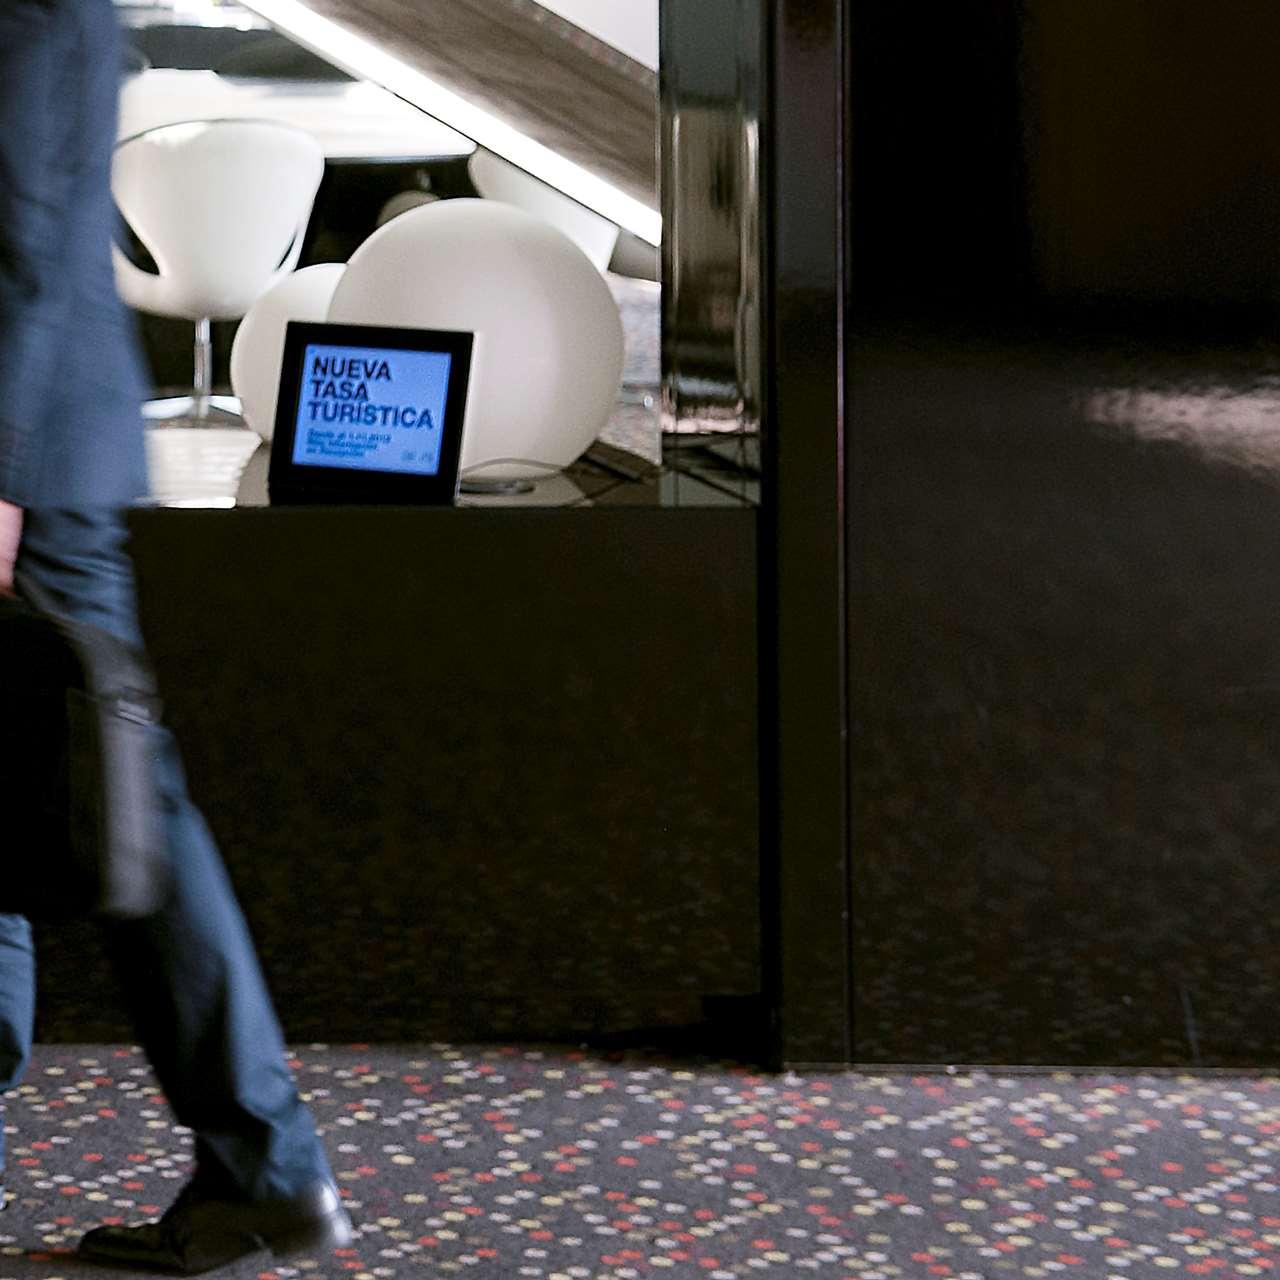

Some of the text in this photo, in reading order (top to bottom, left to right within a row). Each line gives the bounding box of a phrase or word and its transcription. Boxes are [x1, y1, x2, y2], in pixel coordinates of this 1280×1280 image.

[312, 356, 391, 381] NUEVA
[310, 379, 369, 401] TASA
[307, 401, 434, 429] TURÍSTICA
